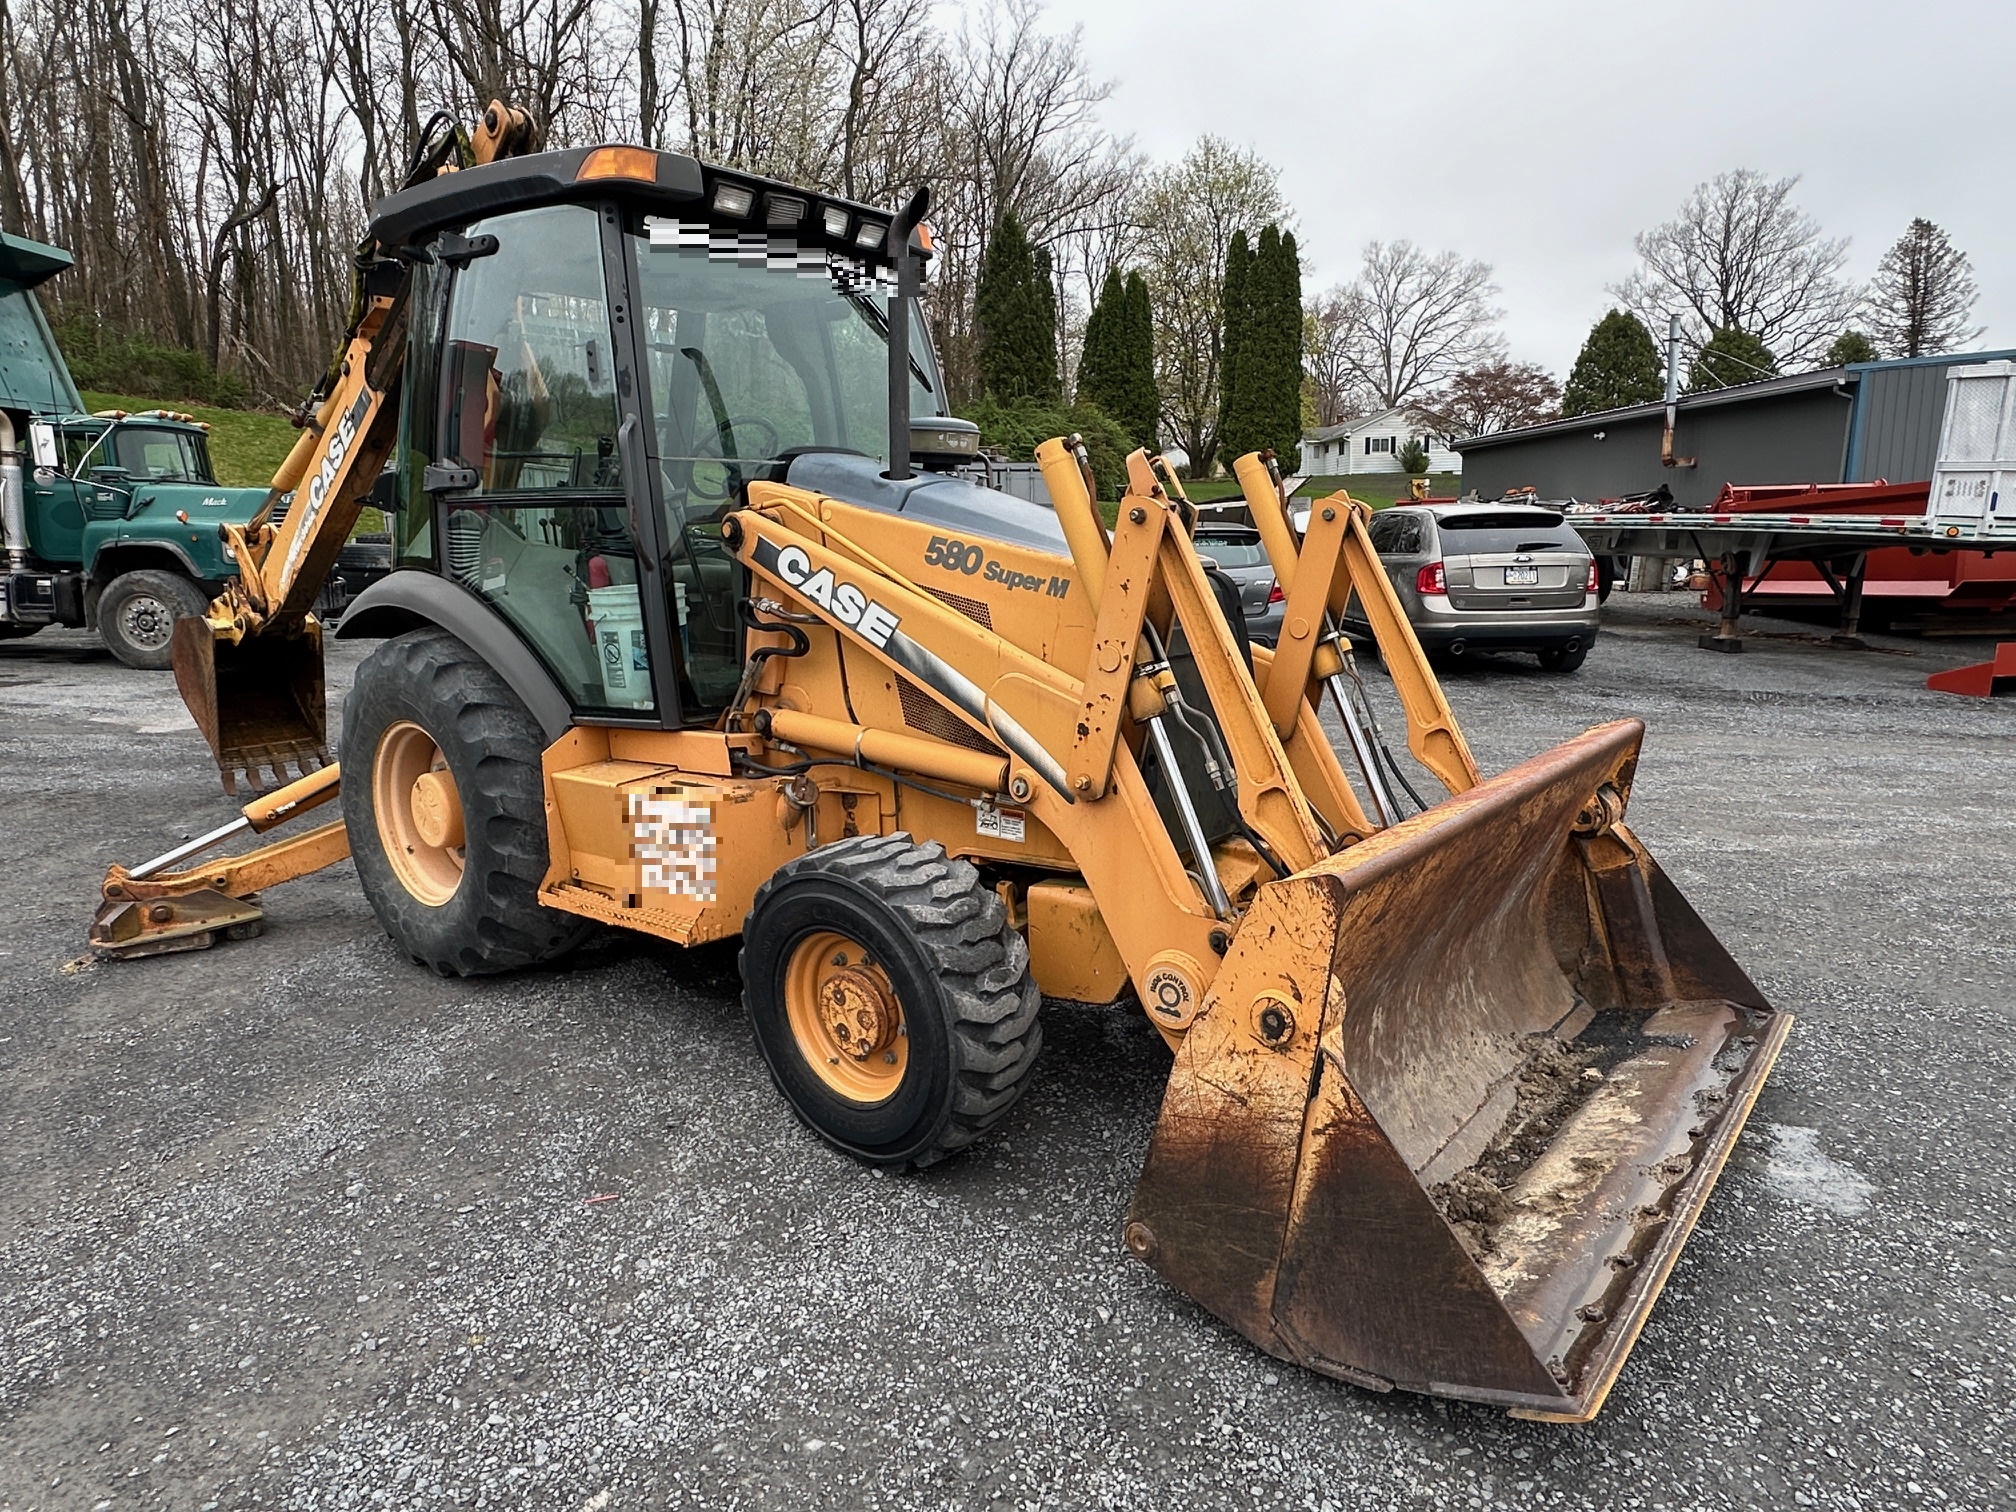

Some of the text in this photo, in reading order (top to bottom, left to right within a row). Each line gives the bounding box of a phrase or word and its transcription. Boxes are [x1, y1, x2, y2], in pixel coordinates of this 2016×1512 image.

[309, 405, 356, 511] CASE
[202, 497, 228, 507] Mack
[777, 544, 902, 650] CASE
[924, 535, 1071, 600] 580 Super M
[1162, 972, 1190, 1003] CONTROL
